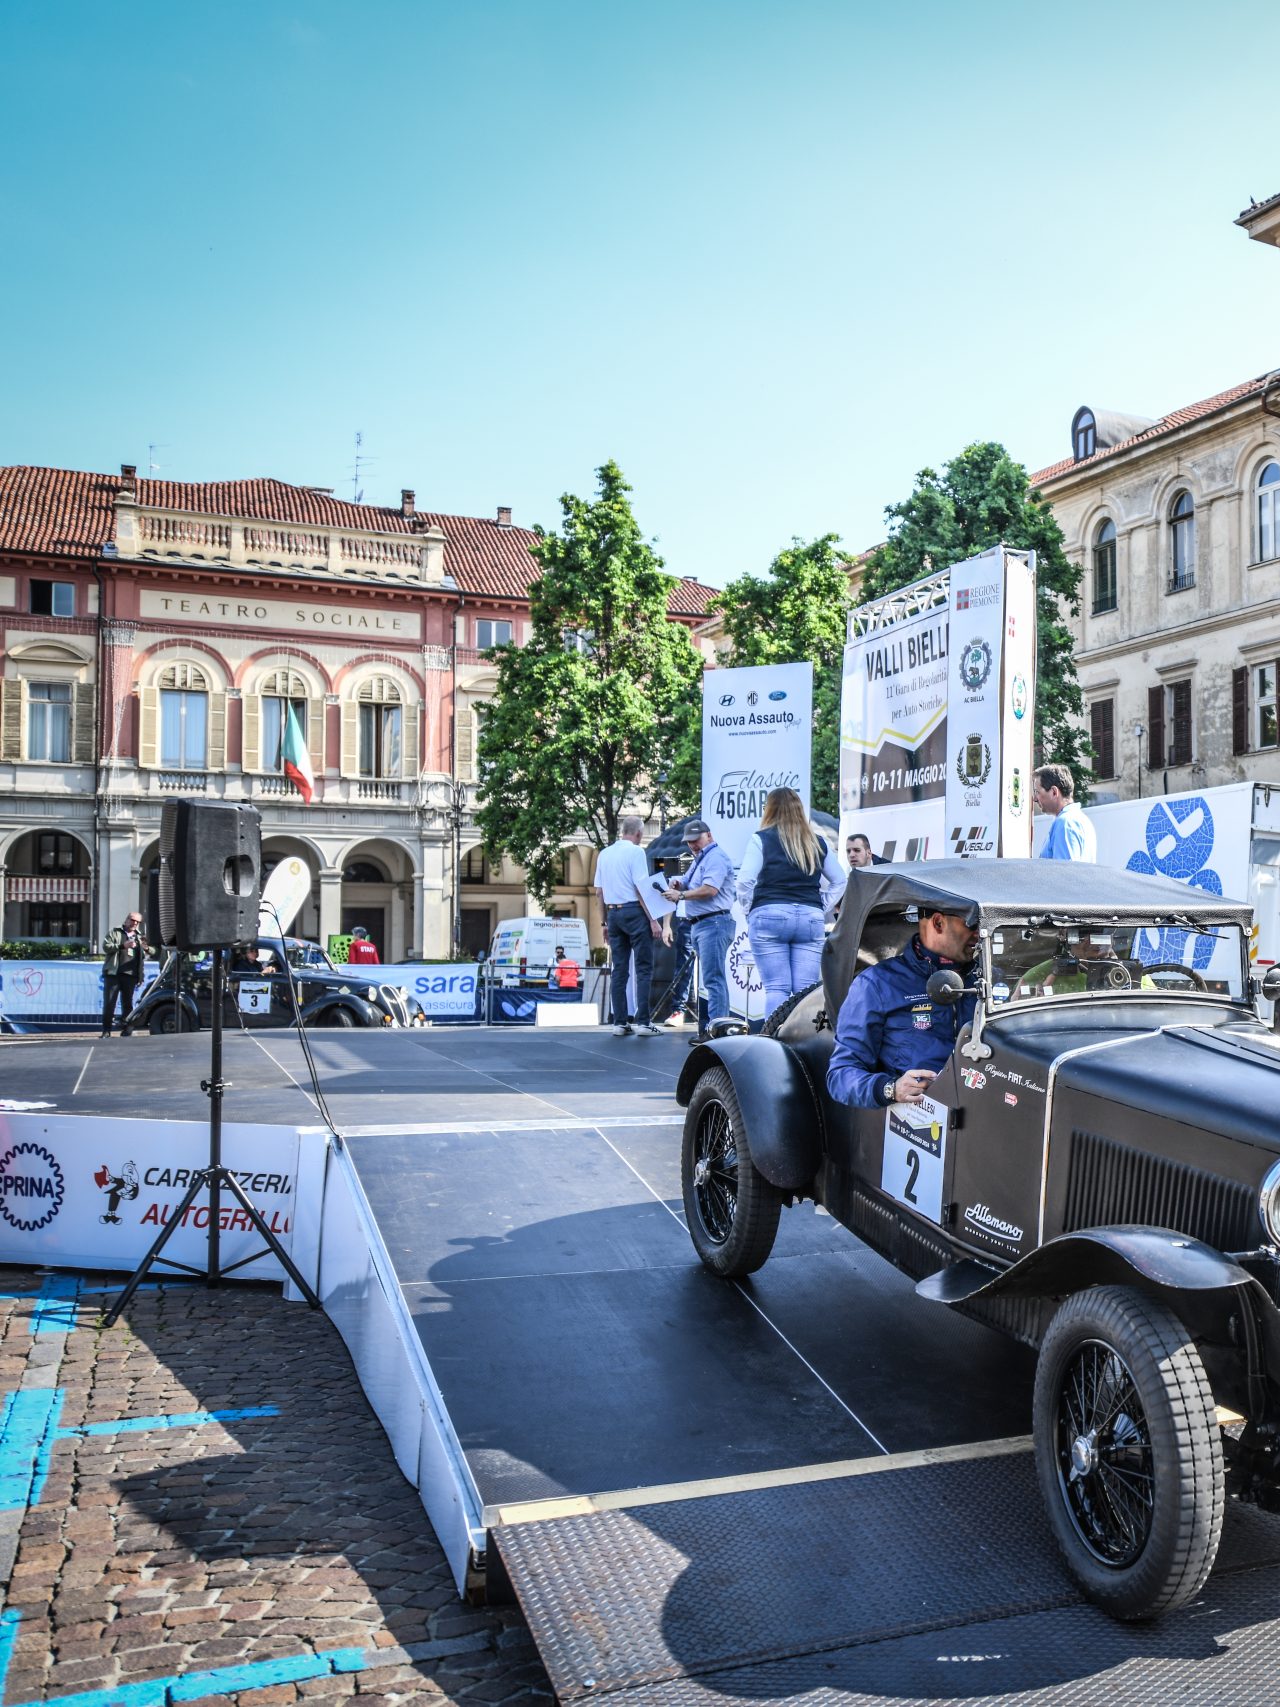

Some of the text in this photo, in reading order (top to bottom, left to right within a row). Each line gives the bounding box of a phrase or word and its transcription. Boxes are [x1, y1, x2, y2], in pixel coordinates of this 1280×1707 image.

[970, 584, 1000, 598] REGIONE
[970, 595, 1000, 608] PIEMONTE
[161, 598, 402, 630] TEATRO SOCIALE
[866, 641, 904, 682] VALLI
[895, 683, 910, 696] Gara
[911, 680, 917, 690] di
[918, 667, 947, 689] Regolarità
[891, 695, 942, 723] per Auto Storiche
[970, 695, 984, 703] BIELLA
[710, 711, 794, 727] Nuova Assauto
[740, 769, 799, 789] classic
[872, 769, 902, 792] 10-11
[904, 764, 938, 788] MAGGIO
[964, 842, 993, 852] VEGLIO
[415, 975, 475, 994] sara
[250, 994, 258, 1007] 3
[425, 1000, 474, 1010] assicura
[985, 1063, 1008, 1079] Registro
[1008, 1071, 1022, 1085] FIAT
[1021, 1079, 1046, 1093] Italiano
[3, 1175, 54, 1198] PRINA
[904, 1148, 920, 1205] 2
[966, 1203, 1021, 1238] Allemano
[1006, 1245, 1020, 1254] time
